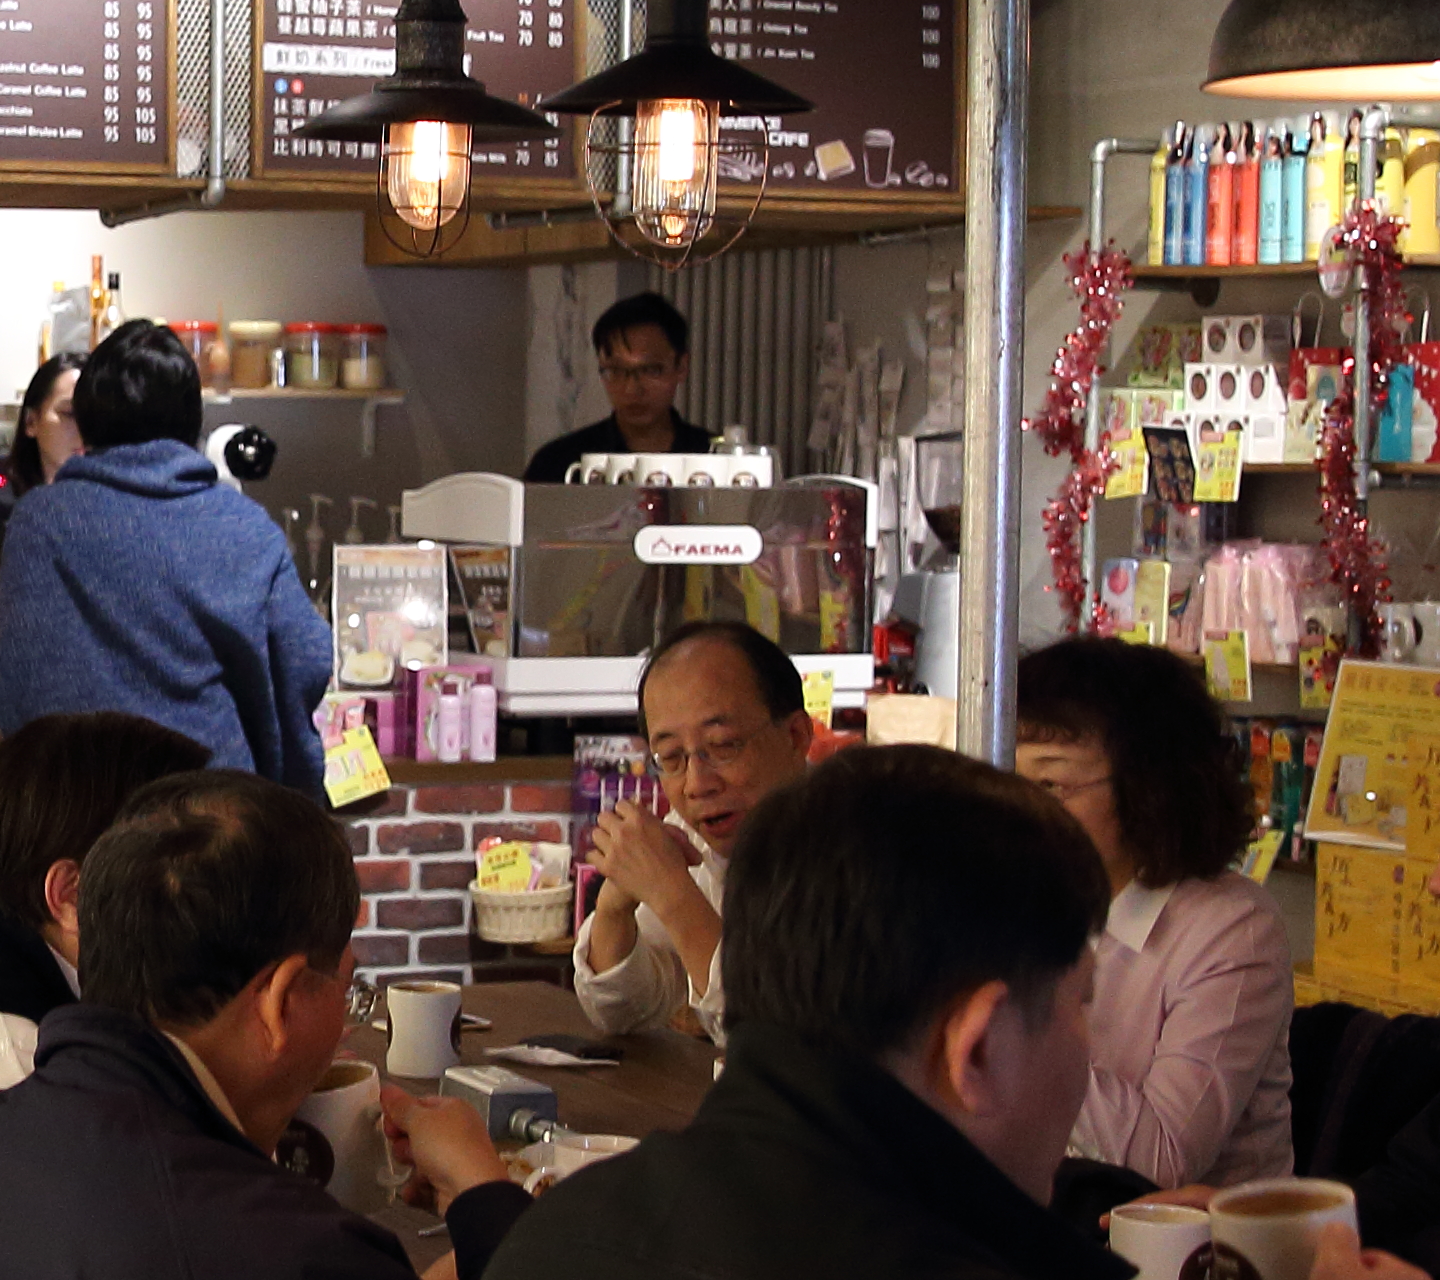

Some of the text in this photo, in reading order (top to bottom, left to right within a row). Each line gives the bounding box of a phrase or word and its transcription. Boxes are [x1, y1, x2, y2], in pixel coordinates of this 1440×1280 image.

[104, 2, 119, 18] 85
[137, 3, 152, 20] 95
[518, 10, 533, 27] 70
[922, 6, 940, 20] 100
[104, 22, 119, 38] 85
[137, 24, 152, 40] 95
[518, 30, 533, 46] 70
[922, 30, 940, 44] 100
[104, 44, 119, 60] 85
[137, 45, 152, 61] 95
[922, 54, 940, 68] 100
[104, 65, 119, 81] 85
[137, 67, 152, 82] 95
[104, 86, 119, 102] 85
[137, 87, 152, 103] 95
[104, 107, 119, 122] 95
[136, 107, 155, 123] 105
[104, 127, 119, 143] 95
[136, 128, 155, 143] 105
[516, 150, 530, 165] 70
[674, 545, 743, 555] FAEMA
